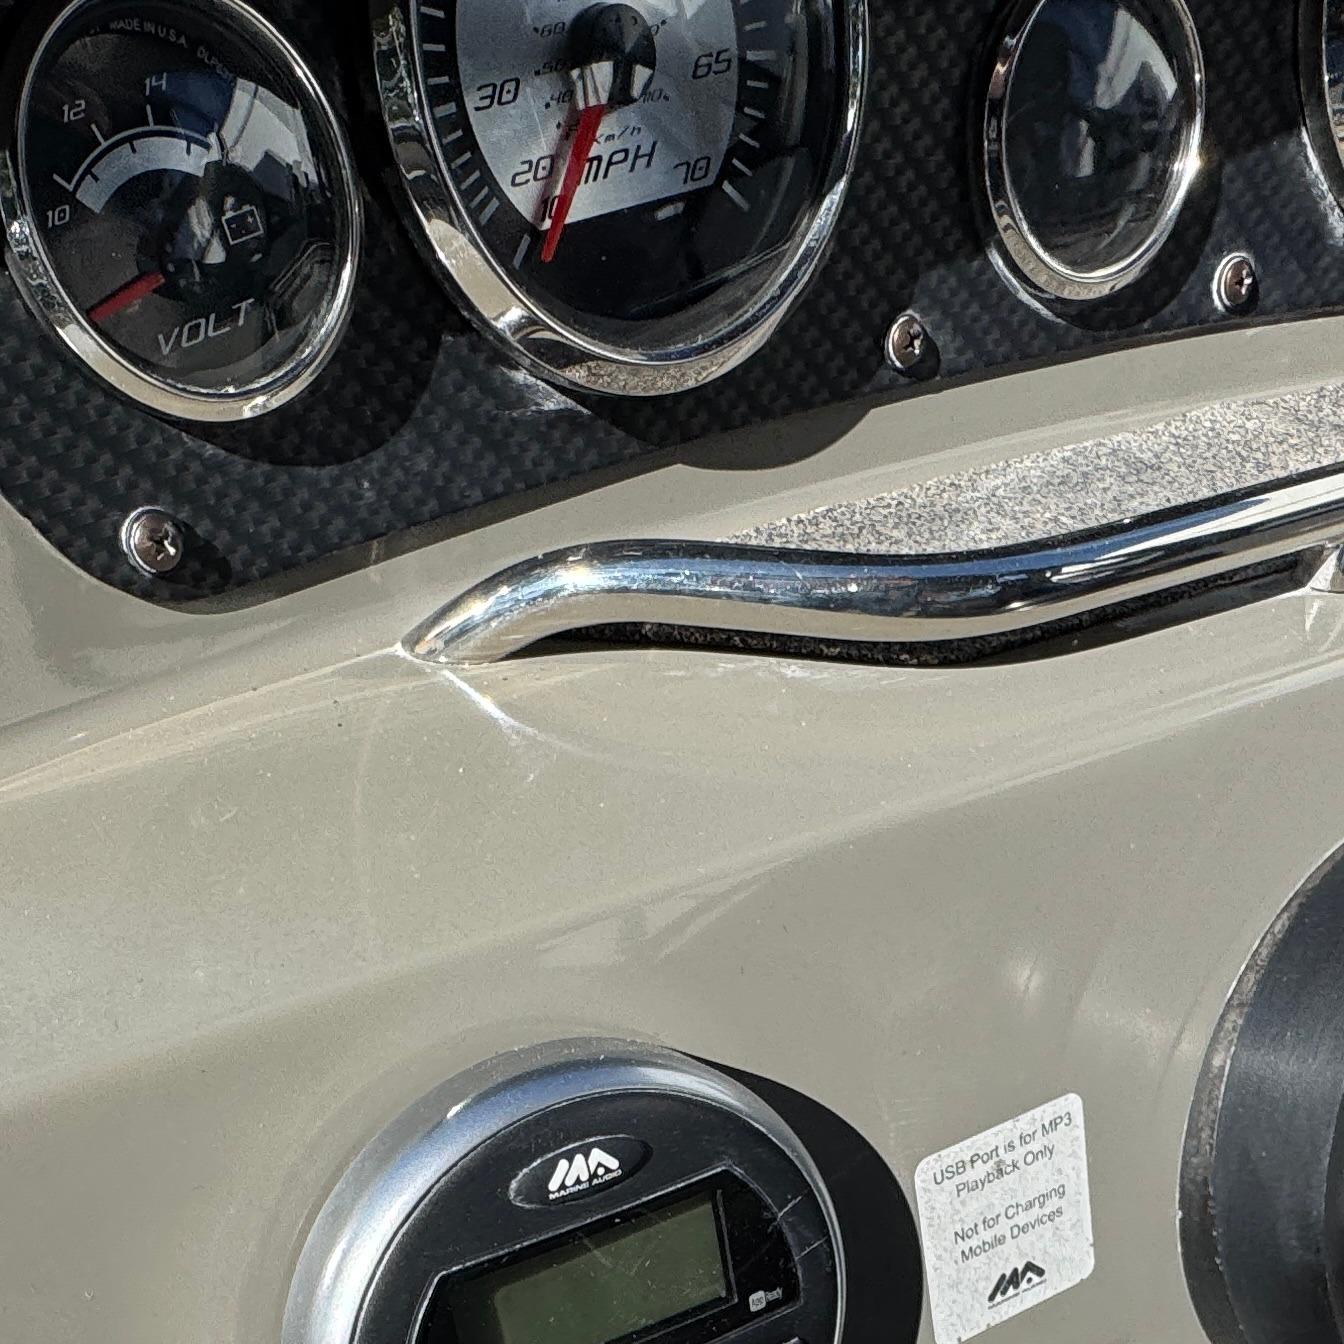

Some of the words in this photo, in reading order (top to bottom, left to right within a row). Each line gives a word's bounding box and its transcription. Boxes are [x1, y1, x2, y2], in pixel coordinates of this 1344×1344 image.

[109, 18, 141, 32] MADE
[691, 48, 733, 80] 65
[145, 72, 168, 96] 14
[473, 76, 521, 112] 30
[62, 99, 86, 124] 12
[510, 154, 555, 188] 20
[580, 141, 658, 186] MPH
[673, 155, 712, 186] 70
[45, 203, 71, 229] 10
[158, 298, 256, 356] VOLT
[933, 1160, 966, 1186] USB
[970, 1145, 1000, 1170] Port
[1003, 1139, 1017, 1154] is
[1019, 1129, 1038, 1147] for
[1041, 1111, 1073, 1138] MP3
[548, 1181, 590, 1200] MARINE
[591, 1169, 623, 1186] AUDIO
[956, 1158, 1021, 1198] Playback
[1023, 1143, 1055, 1166] Only
[954, 1222, 979, 1245] Not
[982, 1212, 1002, 1232] for
[1004, 1183, 1066, 1221] Charging
[961, 1233, 1007, 1264] Mobile
[1010, 1206, 1064, 1241] Devices
